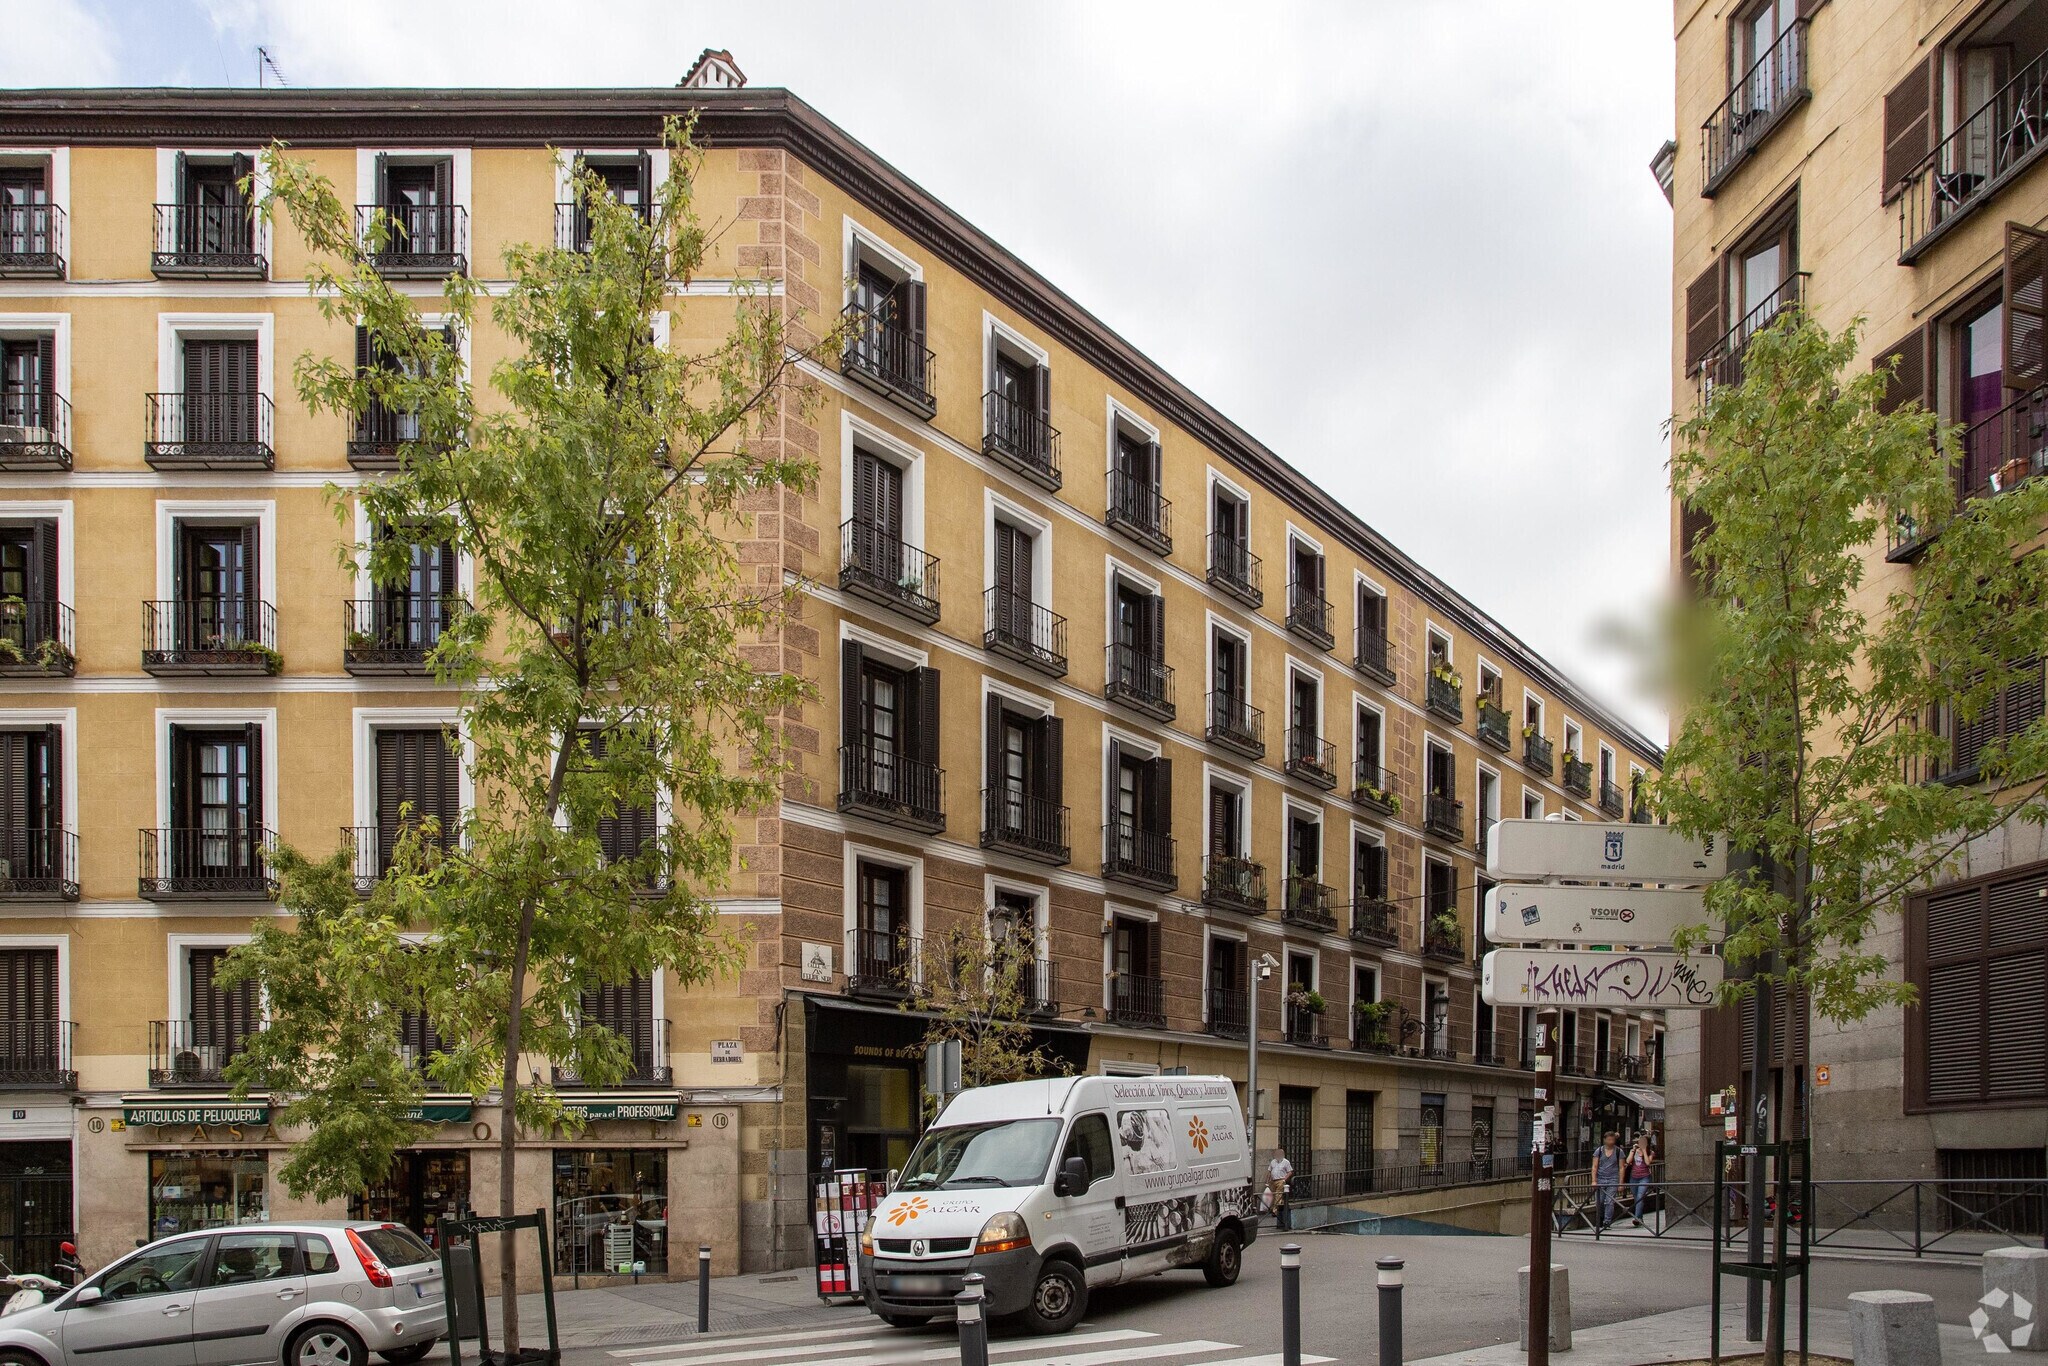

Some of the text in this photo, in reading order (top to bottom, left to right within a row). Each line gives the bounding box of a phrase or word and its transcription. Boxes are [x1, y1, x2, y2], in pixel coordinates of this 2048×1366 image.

[1601, 863, 1625, 871] madrid
[1590, 907, 1619, 917] MOSA
[717, 1041, 738, 1049] PLAZA
[854, 1045, 883, 1057] SOUNDS
[884, 1048, 894, 1057] OF
[1113, 1084, 1146, 1098] Selección
[1147, 1085, 1156, 1097] de
[1176, 1083, 1198, 1099] Quesos
[1198, 1087, 1203, 1098] y
[1203, 1083, 1228, 1096] Jamones
[14, 1110, 24, 1119] 10
[130, 1108, 261, 1122] ARTICULOS DE PELUQUERIA
[589, 1111, 608, 1119] para
[608, 1109, 616, 1118] el
[617, 1104, 675, 1118] PROFESIONAL
[91, 1119, 101, 1130] 10
[715, 1116, 727, 1127] 10
[1211, 1131, 1235, 1142] ALGAR
[1144, 1167, 1220, 1189] www.grupoalgar.com
[925, 1205, 981, 1214] ALGAR
